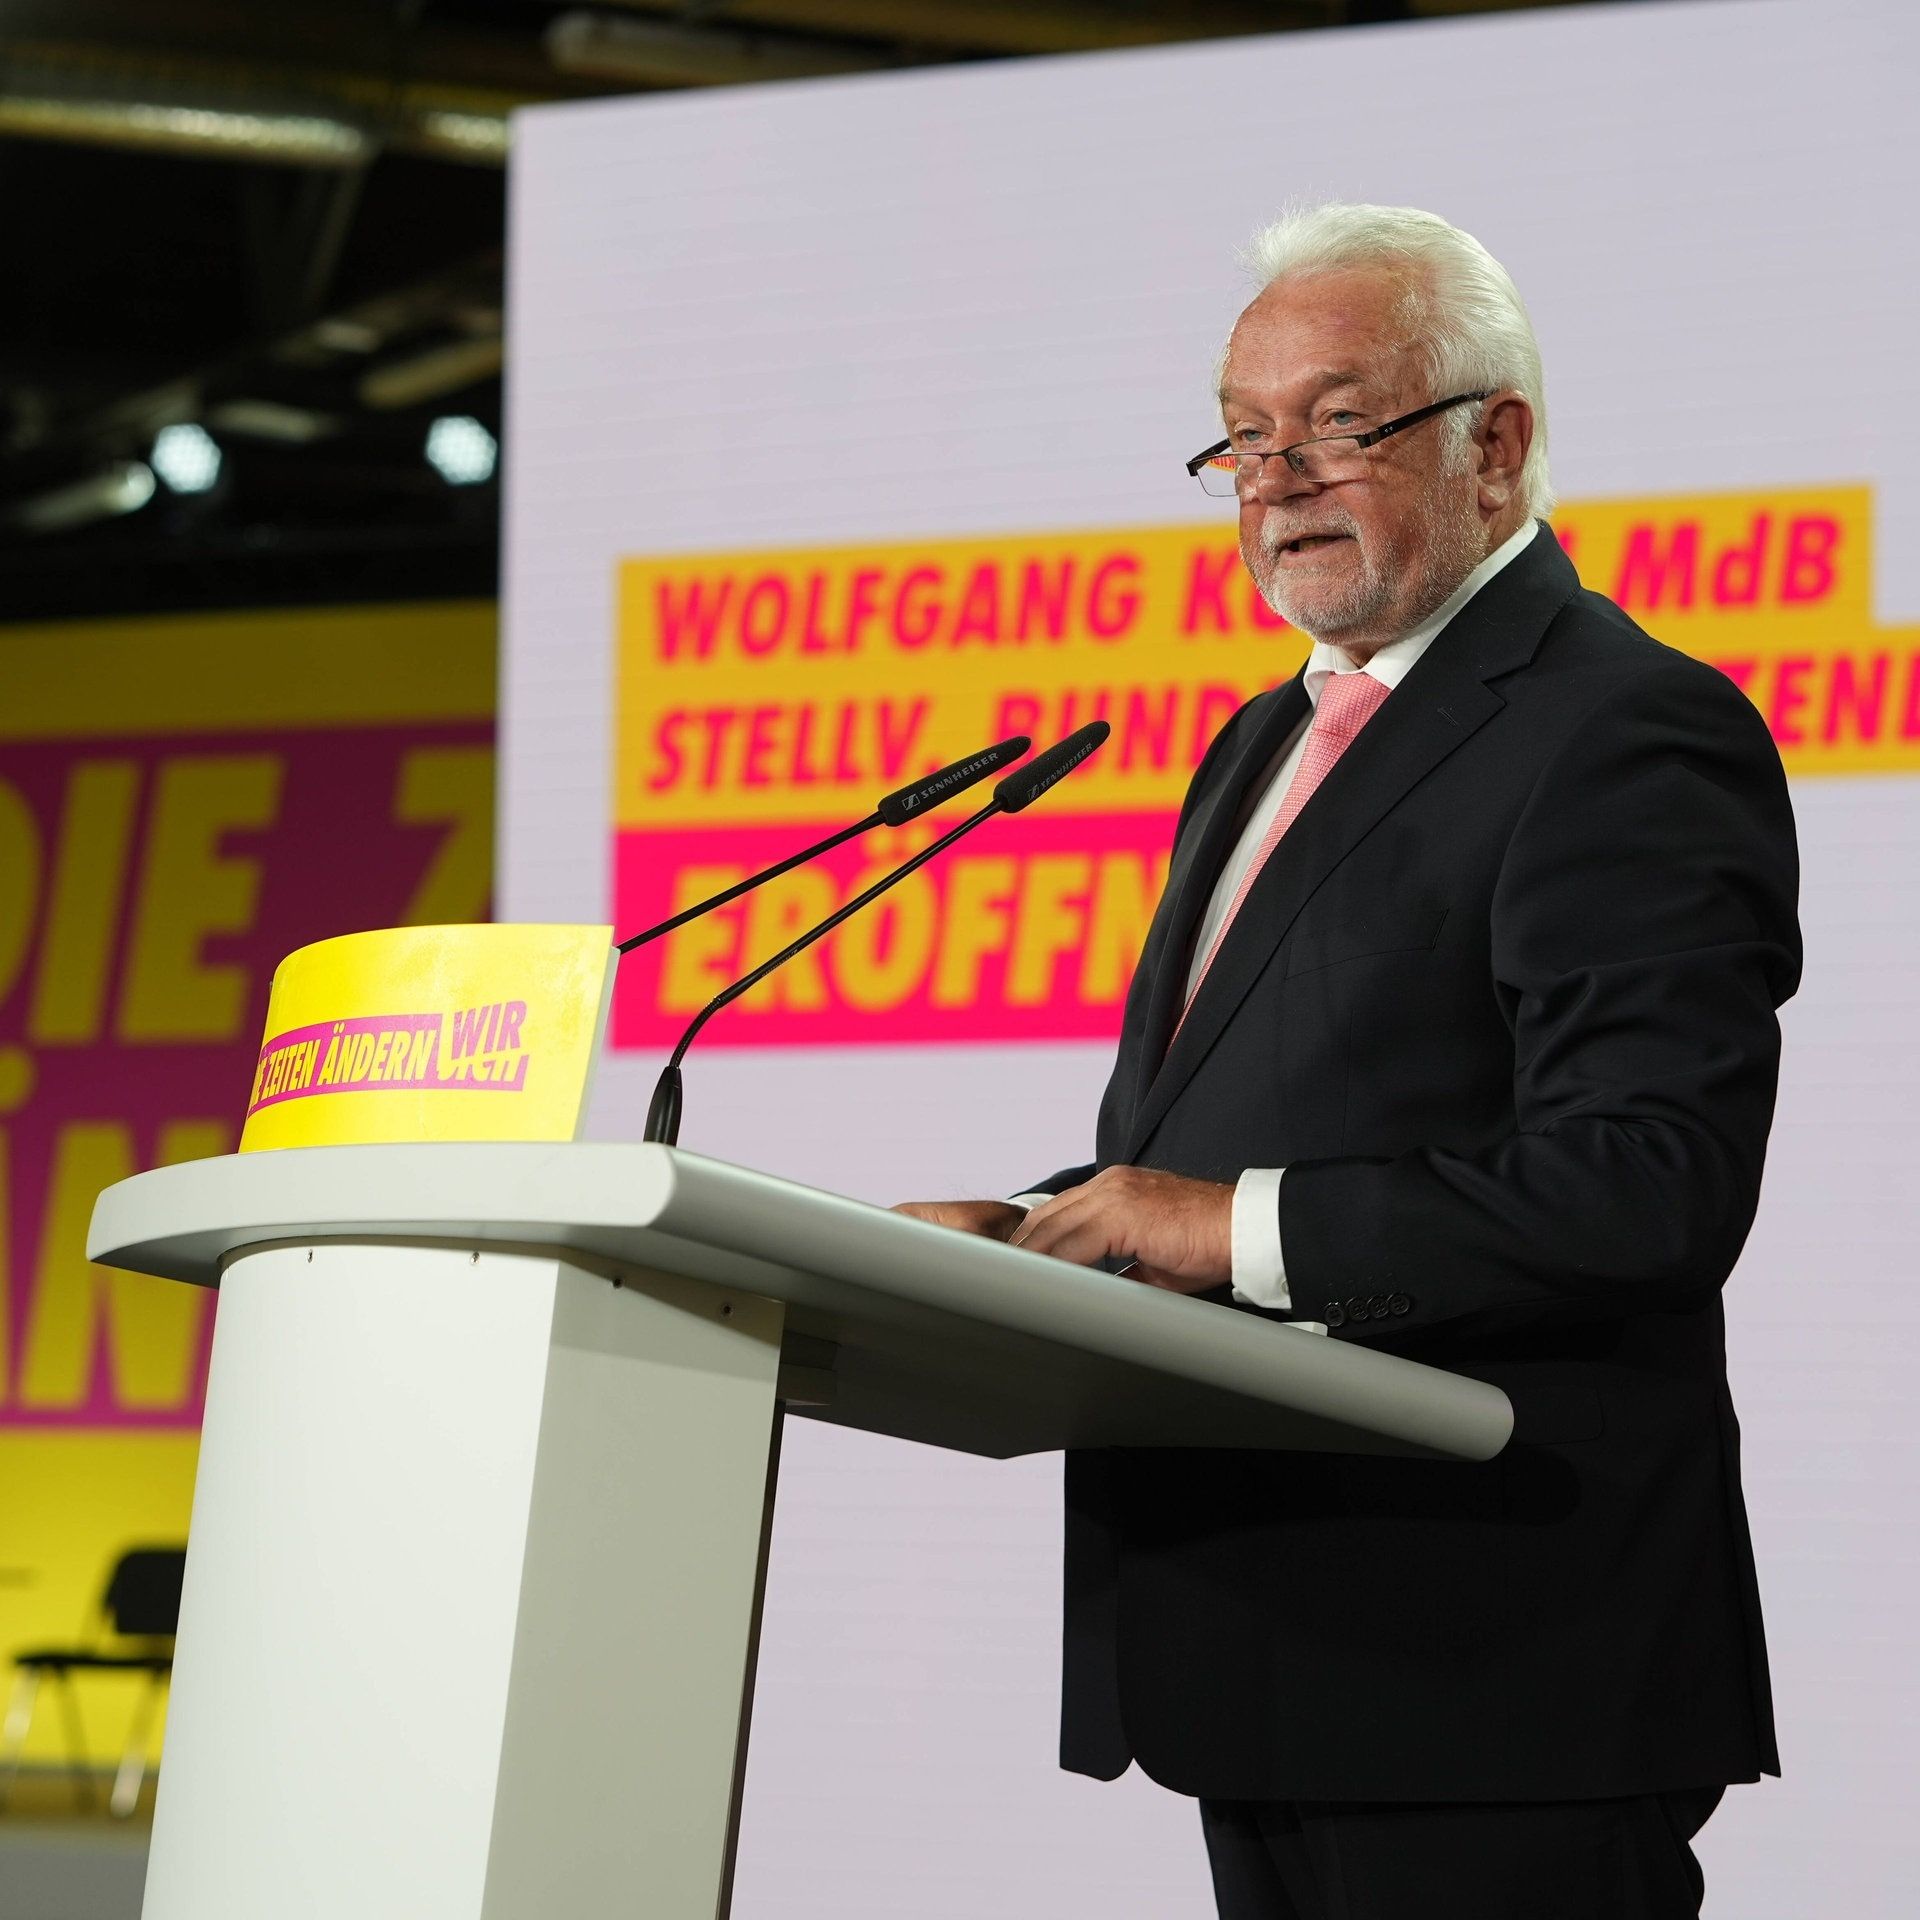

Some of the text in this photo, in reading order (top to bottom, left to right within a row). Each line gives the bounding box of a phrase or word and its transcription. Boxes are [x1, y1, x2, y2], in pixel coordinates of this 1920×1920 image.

[653, 554, 1142, 665] WOLFGANG
[1612, 511, 1842, 609] MdB
[645, 697, 945, 795] STELLV.
[920, 752, 999, 799] SENNHEISER
[1041, 742, 1093, 790] SENNHEISER
[261, 1039, 321, 1101] ZEITEN
[317, 1022, 436, 1087] ÄNDERN
[451, 1000, 527, 1060] WIR
